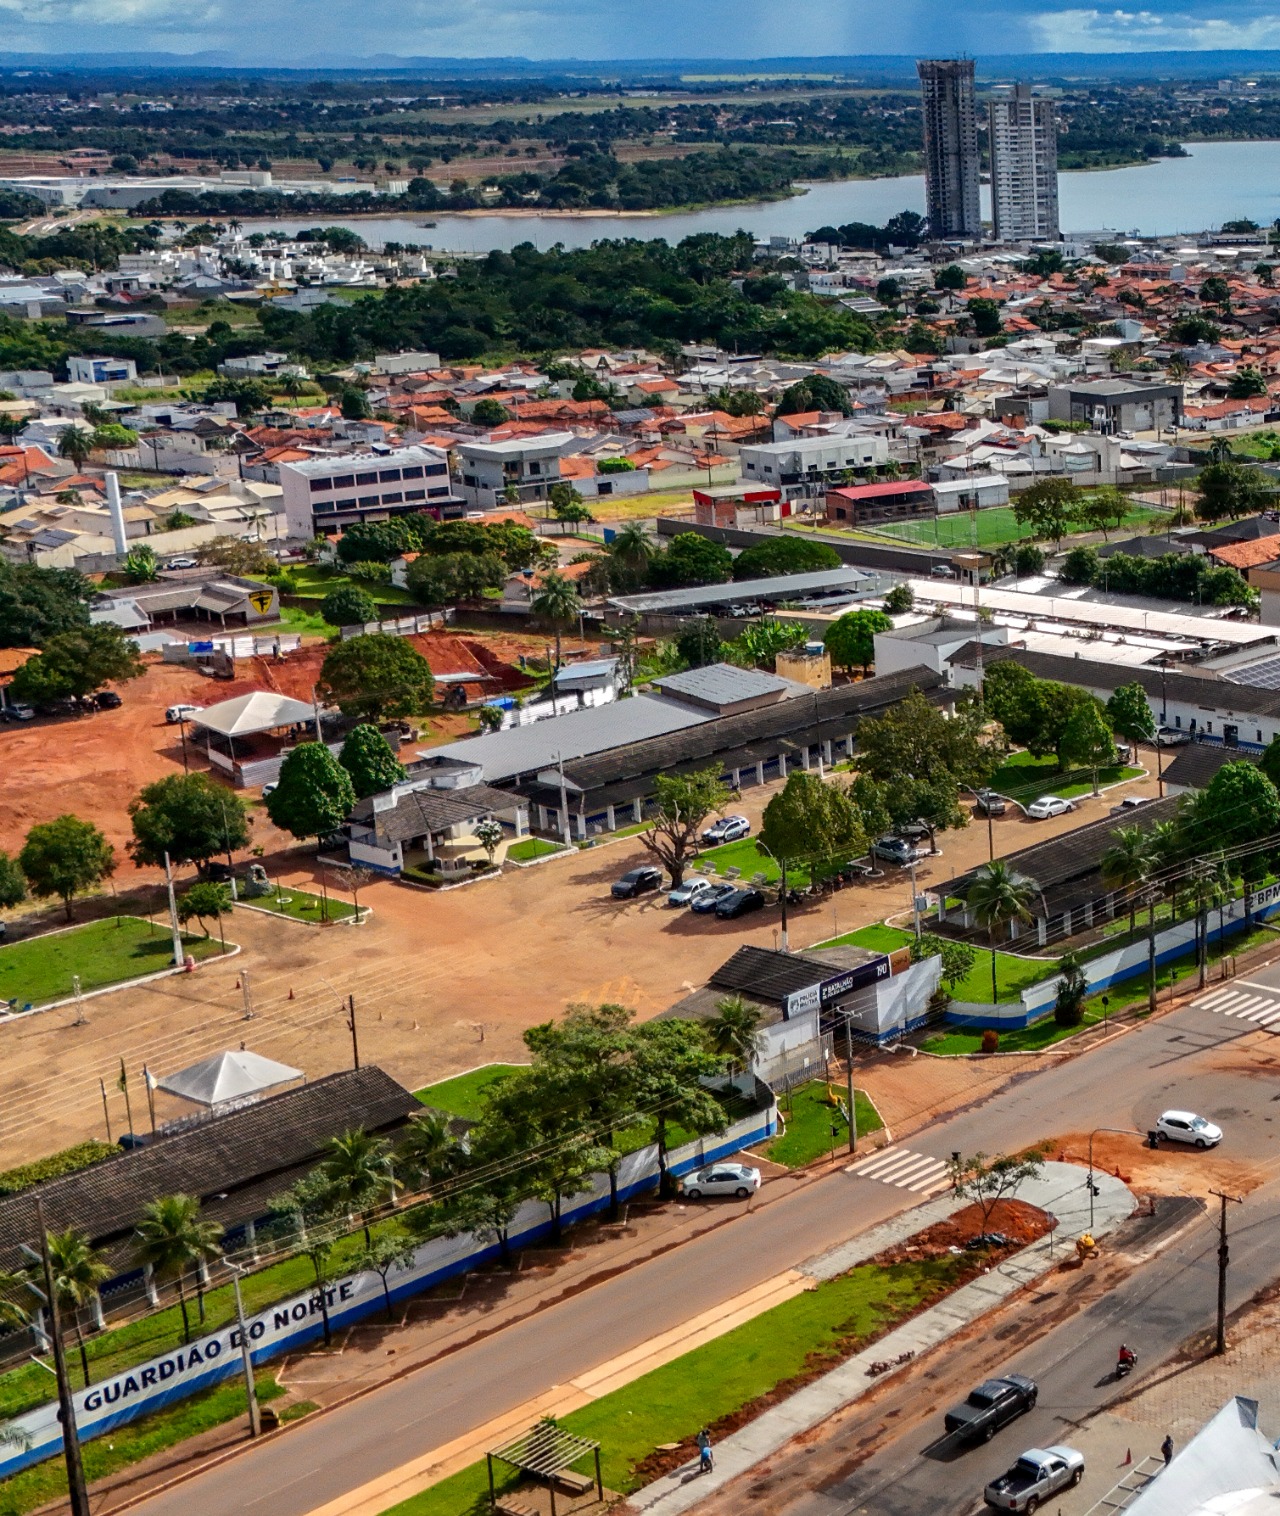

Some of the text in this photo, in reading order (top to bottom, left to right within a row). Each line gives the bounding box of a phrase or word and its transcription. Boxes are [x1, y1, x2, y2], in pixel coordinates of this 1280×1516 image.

[876, 963, 887, 977] 190
[84, 1339, 222, 1412] GUARDIÃO
[274, 1281, 354, 1330] NORTE
